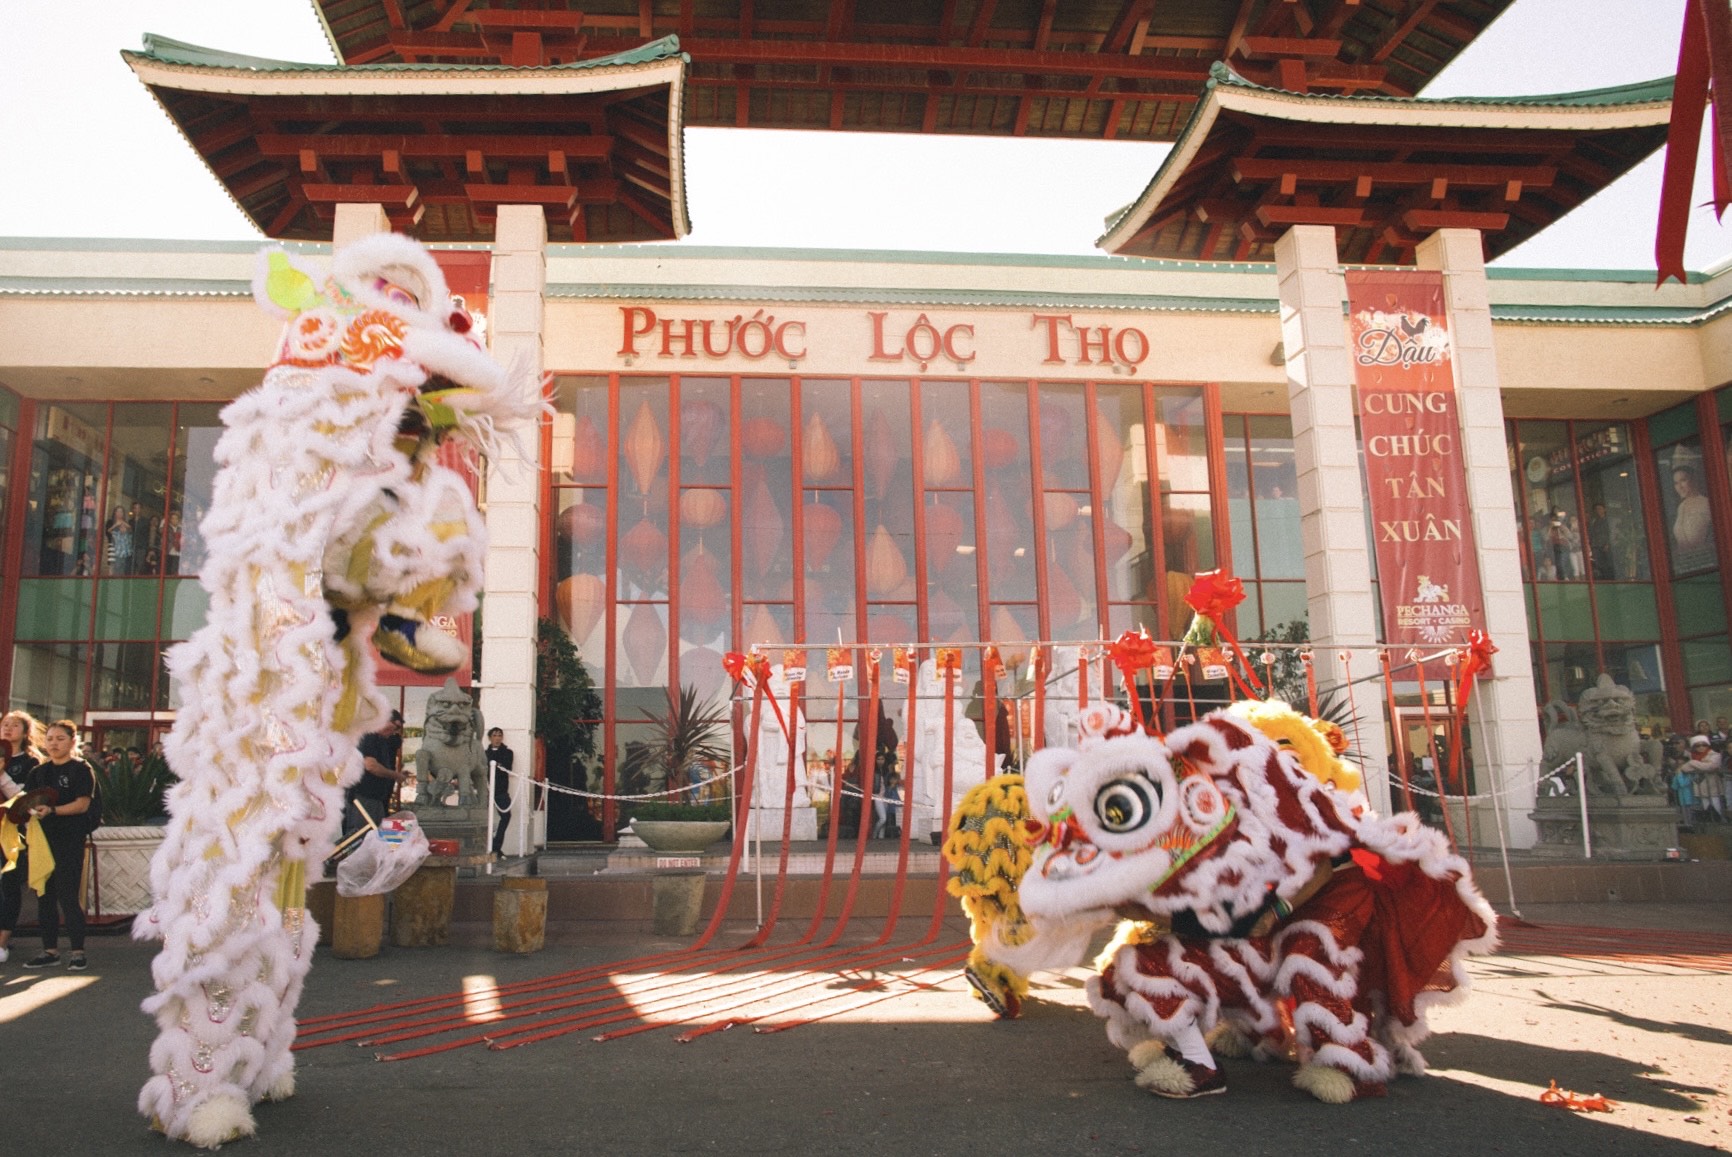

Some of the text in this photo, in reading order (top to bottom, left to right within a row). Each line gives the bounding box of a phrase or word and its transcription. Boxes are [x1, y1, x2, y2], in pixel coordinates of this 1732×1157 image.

[617, 306, 1151, 375] PHƯỚC LỘC THỌ
[1359, 329, 1436, 368] Dậu
[1364, 392, 1447, 415] CUNG
[1369, 429, 1454, 457] CHÚC
[1385, 471, 1446, 499] TÂN
[1380, 513, 1462, 542] XUÂN
[1396, 604, 1470, 617] PECHANGA
[1397, 617, 1471, 626] RESORT CASINO
